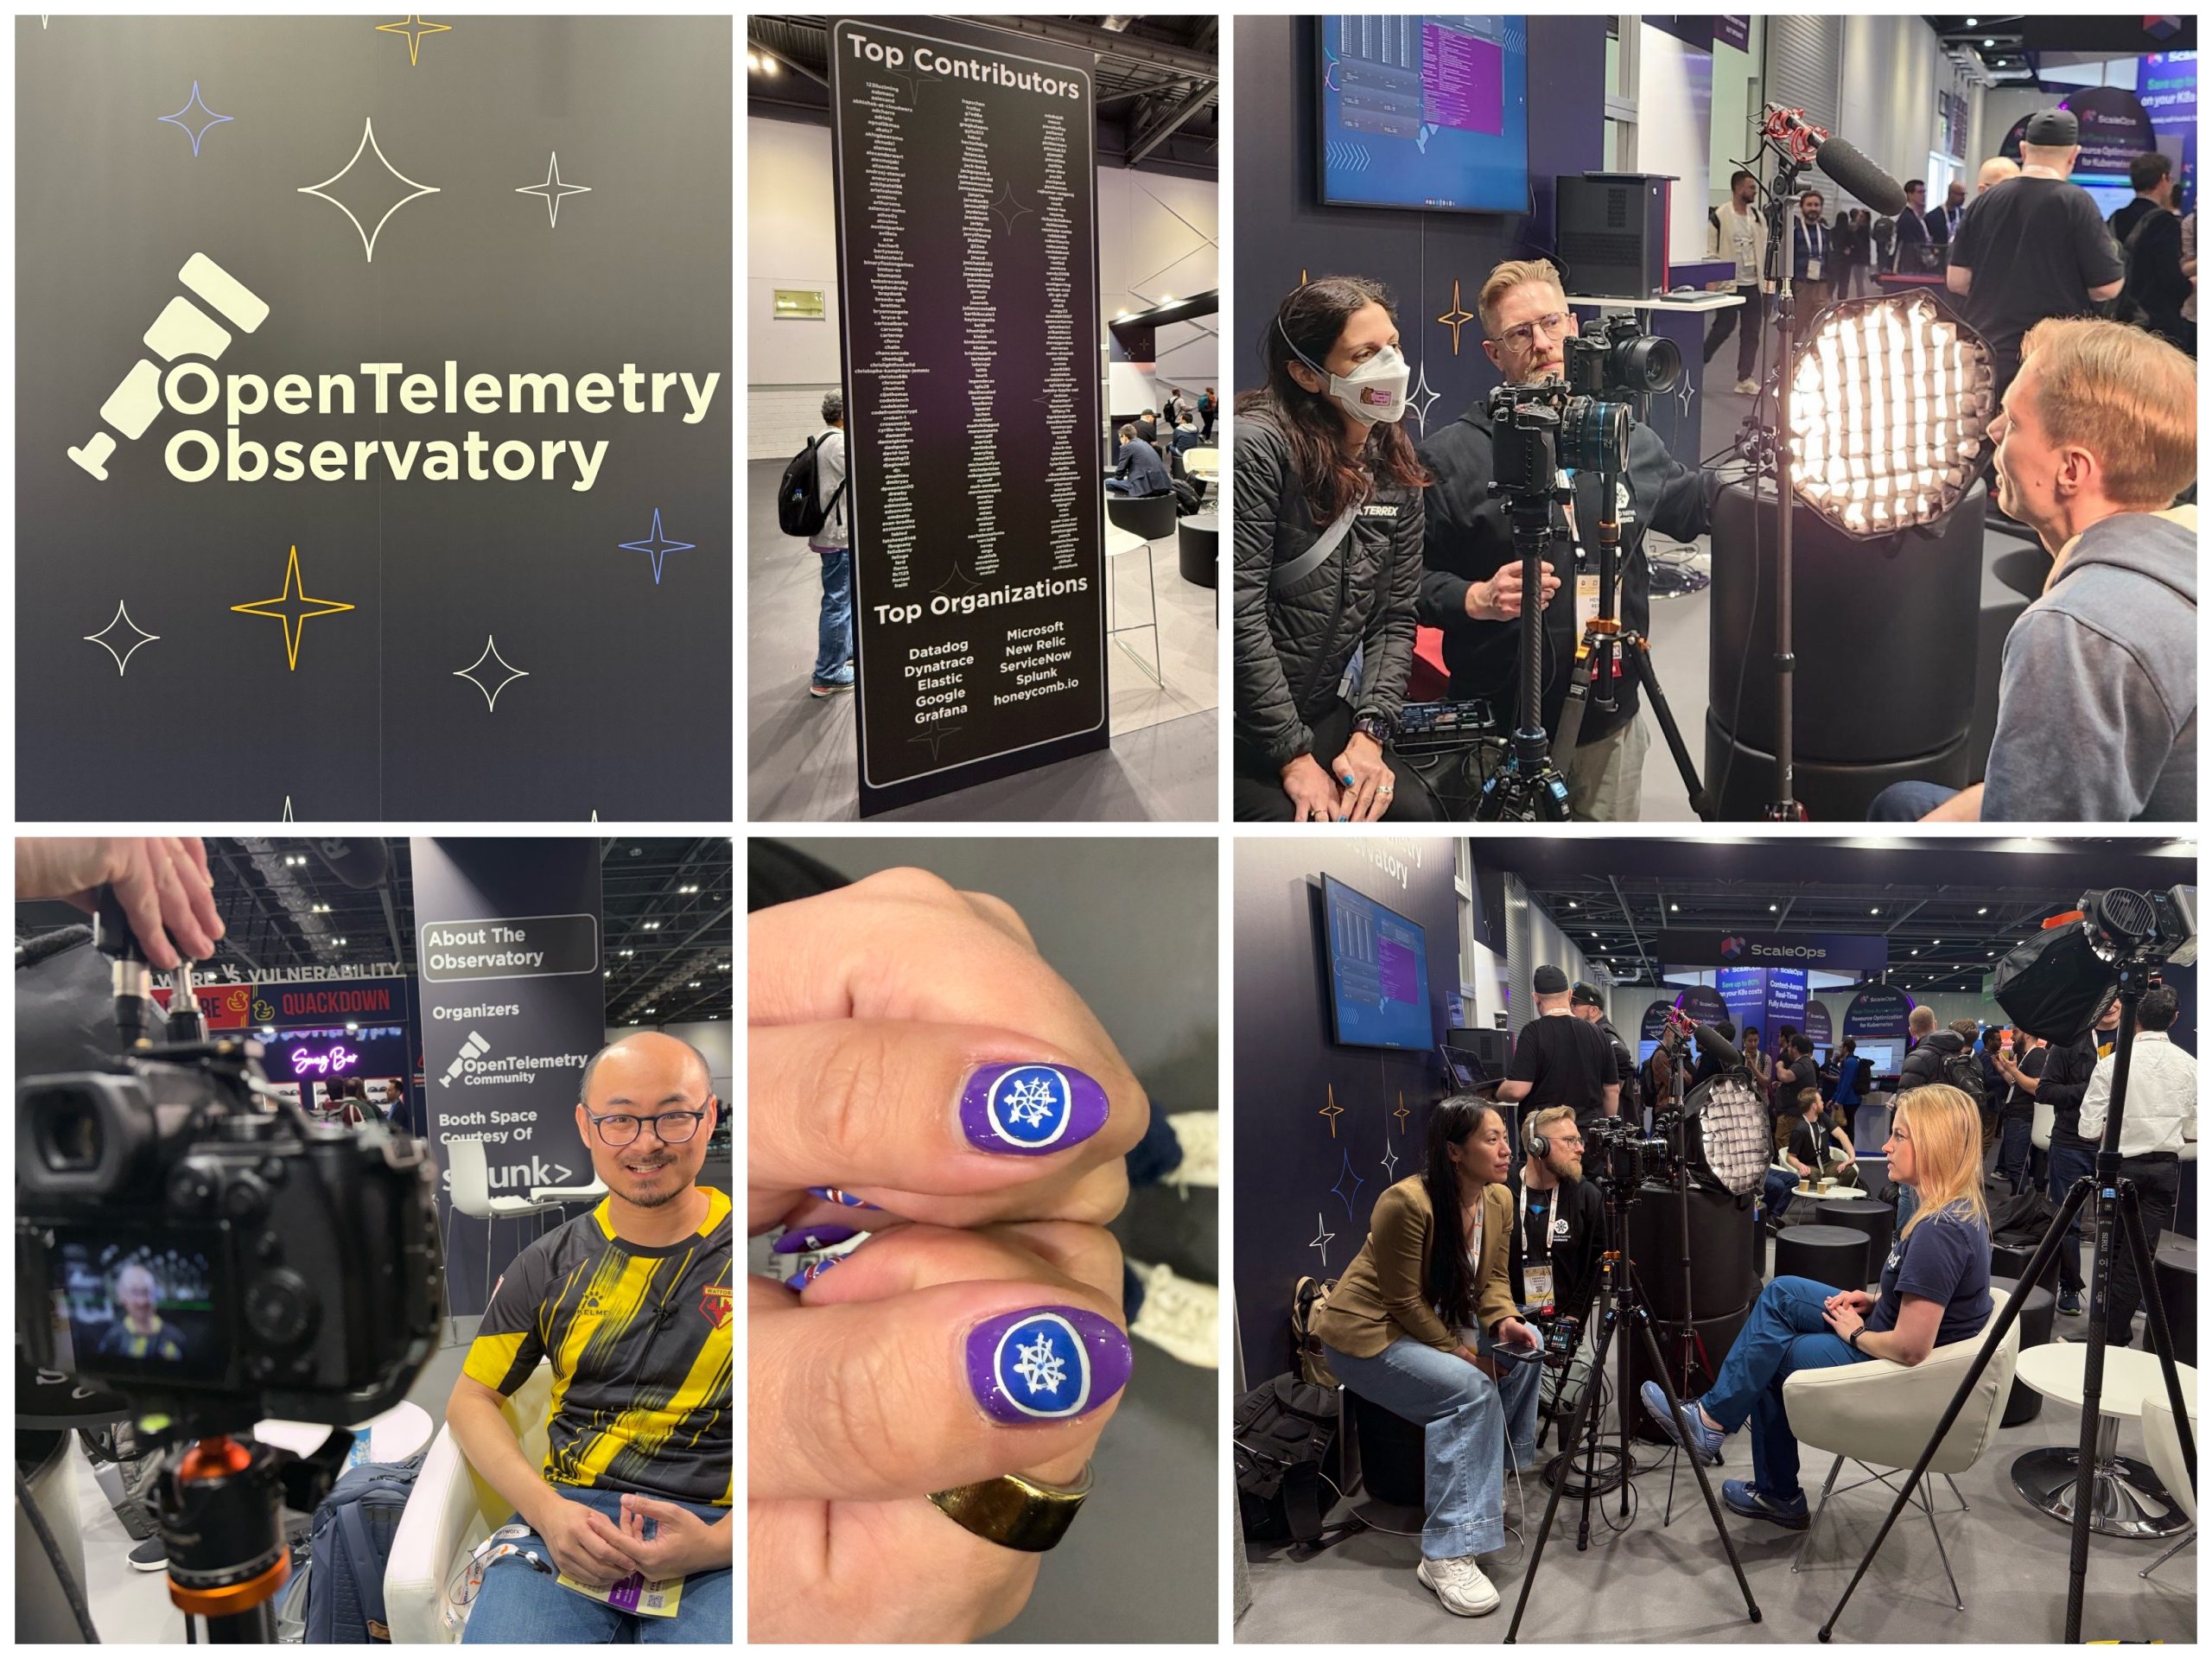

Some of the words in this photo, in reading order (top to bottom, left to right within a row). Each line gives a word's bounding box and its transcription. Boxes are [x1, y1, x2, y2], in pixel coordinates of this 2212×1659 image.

[847, 33, 904, 69] Top
[913, 48, 1080, 99] Contributors
[2153, 95, 2176, 109] your
[164, 361, 720, 424] OpenTelemetry
[164, 429, 608, 491] Observatory
[1363, 506, 1399, 517] TERREX
[874, 603, 922, 625] Top
[931, 577, 1088, 615] Organizations
[1007, 620, 1065, 641] Microsoft
[909, 639, 969, 661] Datadog
[1006, 645, 1033, 657] New
[1036, 636, 1066, 652] Relic
[905, 654, 975, 678] Dynatrace
[1000, 650, 1072, 673] ServiceNow
[918, 672, 963, 691] Elastic
[1016, 667, 1058, 686] Splunk
[915, 688, 966, 709] Google
[994, 677, 1079, 706] honeycomb.io
[915, 703, 968, 724] Grafana
[429, 927, 486, 948] About
[491, 926, 526, 944] The
[429, 950, 544, 971] Observatory
[1751, 943, 1827, 960] ScaleOps
[248, 962, 401, 983] VULNERABILITY
[1726, 989, 1738, 999] your
[1770, 980, 1803, 991] Context-Aware
[1775, 990, 1798, 1000] Real-Time
[283, 988, 391, 1016] QUACKDOWN
[432, 1002, 520, 1021] Organizers
[1768, 999, 1779, 1008] Fully
[1779, 1001, 1804, 1010] Automated
[463, 1053, 588, 1074] OpenTelemetry
[464, 1071, 536, 1086] Community
[439, 1110, 486, 1127] Booth
[490, 1110, 537, 1126] Space
[513, 1126, 532, 1141] Of
